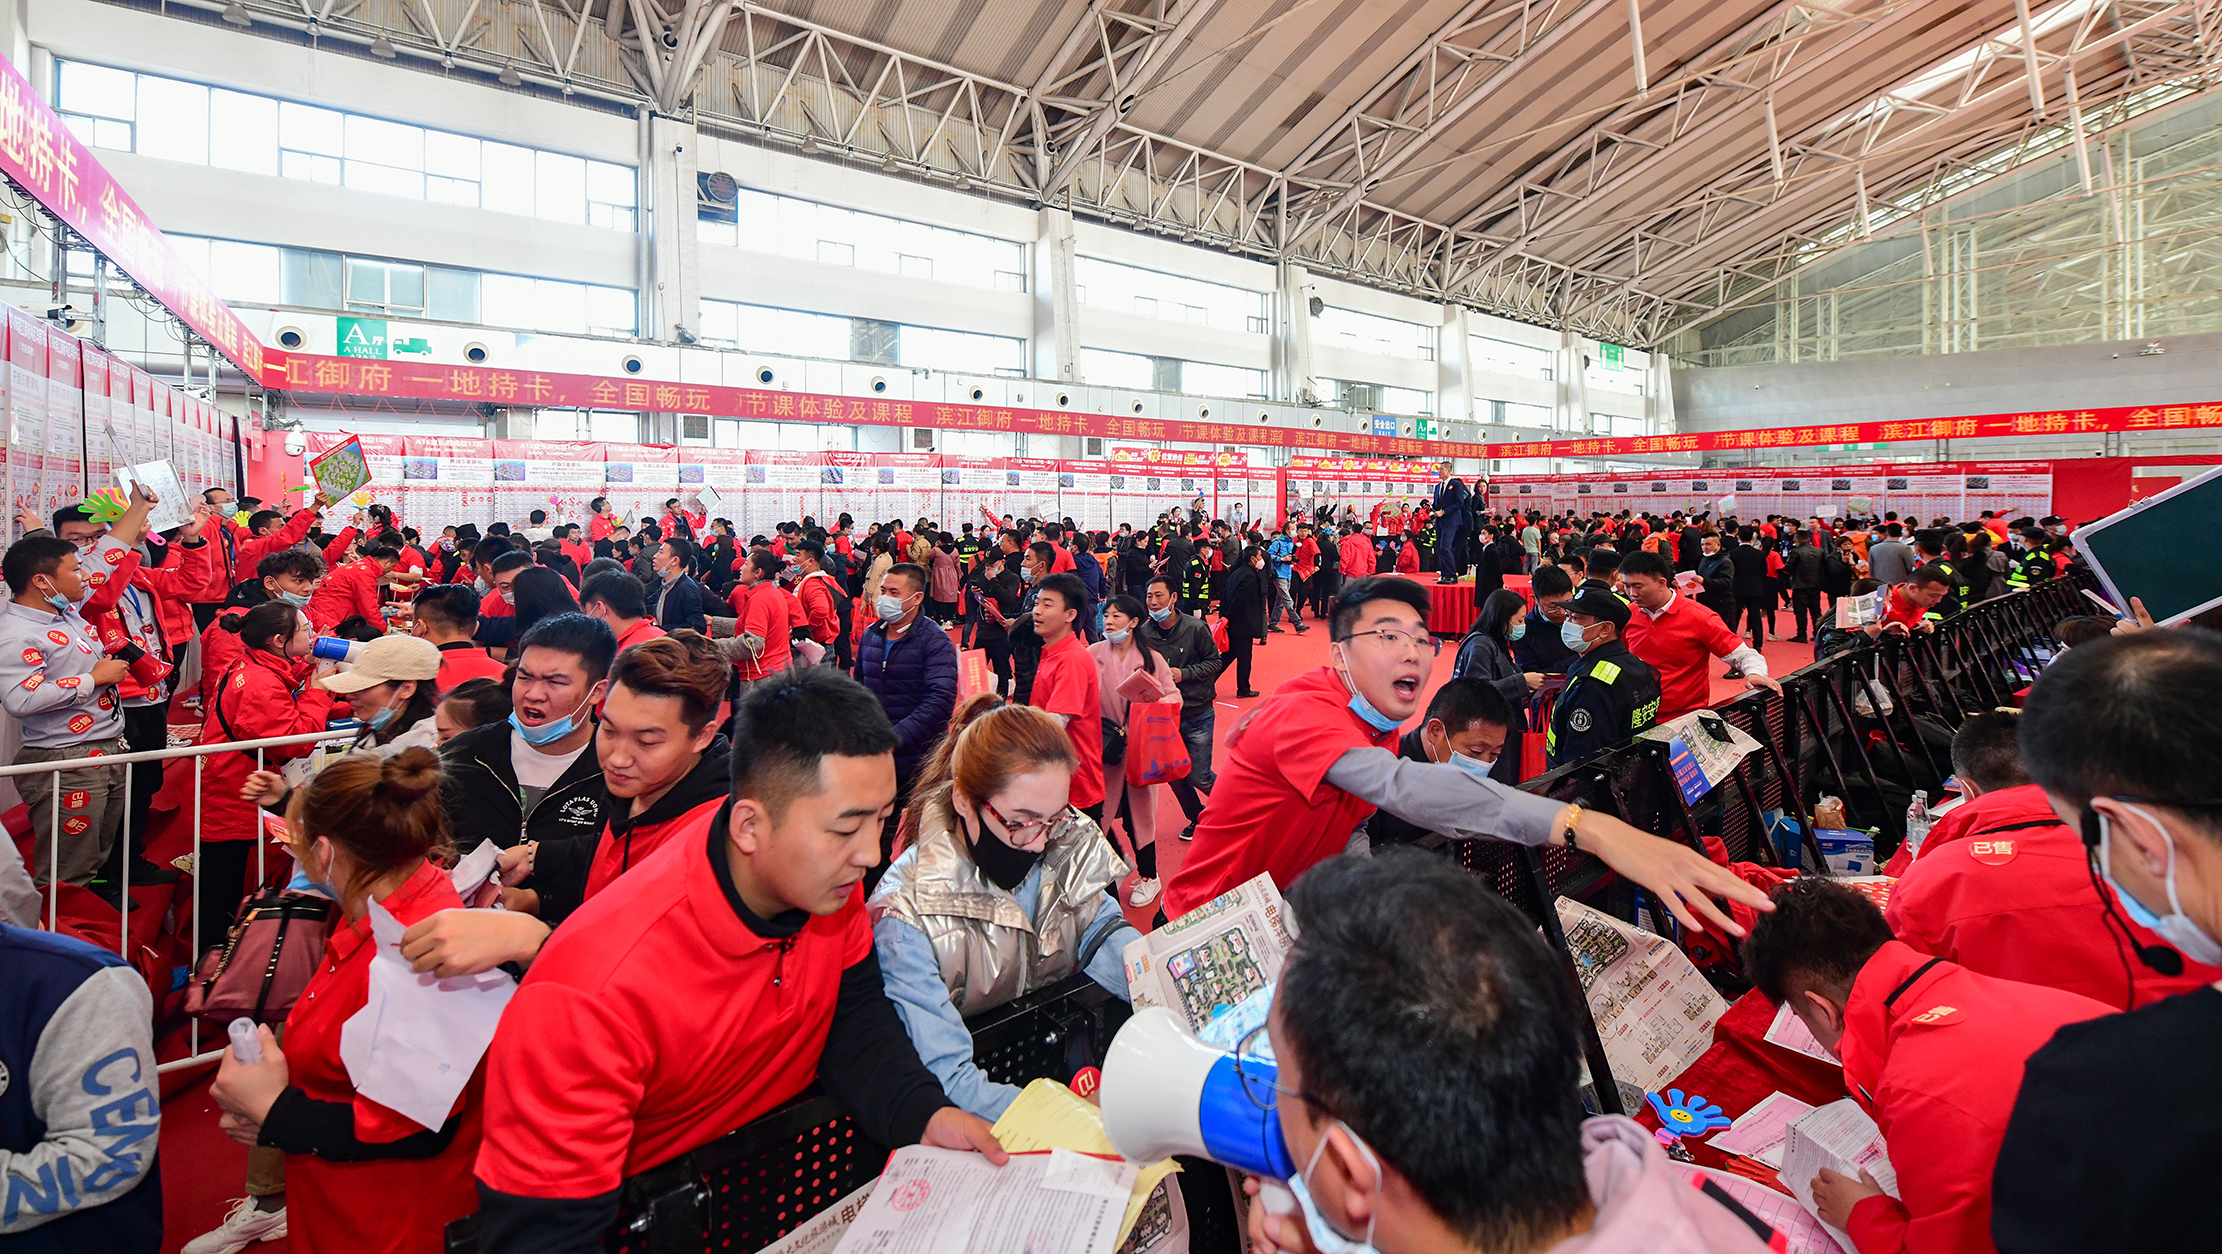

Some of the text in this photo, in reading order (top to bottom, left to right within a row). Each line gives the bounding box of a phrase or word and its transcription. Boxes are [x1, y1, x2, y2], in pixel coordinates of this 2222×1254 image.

[354, 346, 382, 355] HALL
[936, 406, 1013, 429] 滨江御府
[1295, 430, 1338, 448] 滨江御府
[1374, 419, 1396, 430] 安全出口
[1500, 441, 1553, 457] 滨江御府
[1882, 418, 1979, 439] 滨江御府
[105, 551, 124, 563] 已售
[48, 632, 68, 645] 已售
[24, 652, 43, 663] 已售
[71, 715, 92, 732] 已售
[71, 791, 84, 808] 已售
[67, 817, 88, 832] 已售
[1973, 840, 2013, 856] 已售
